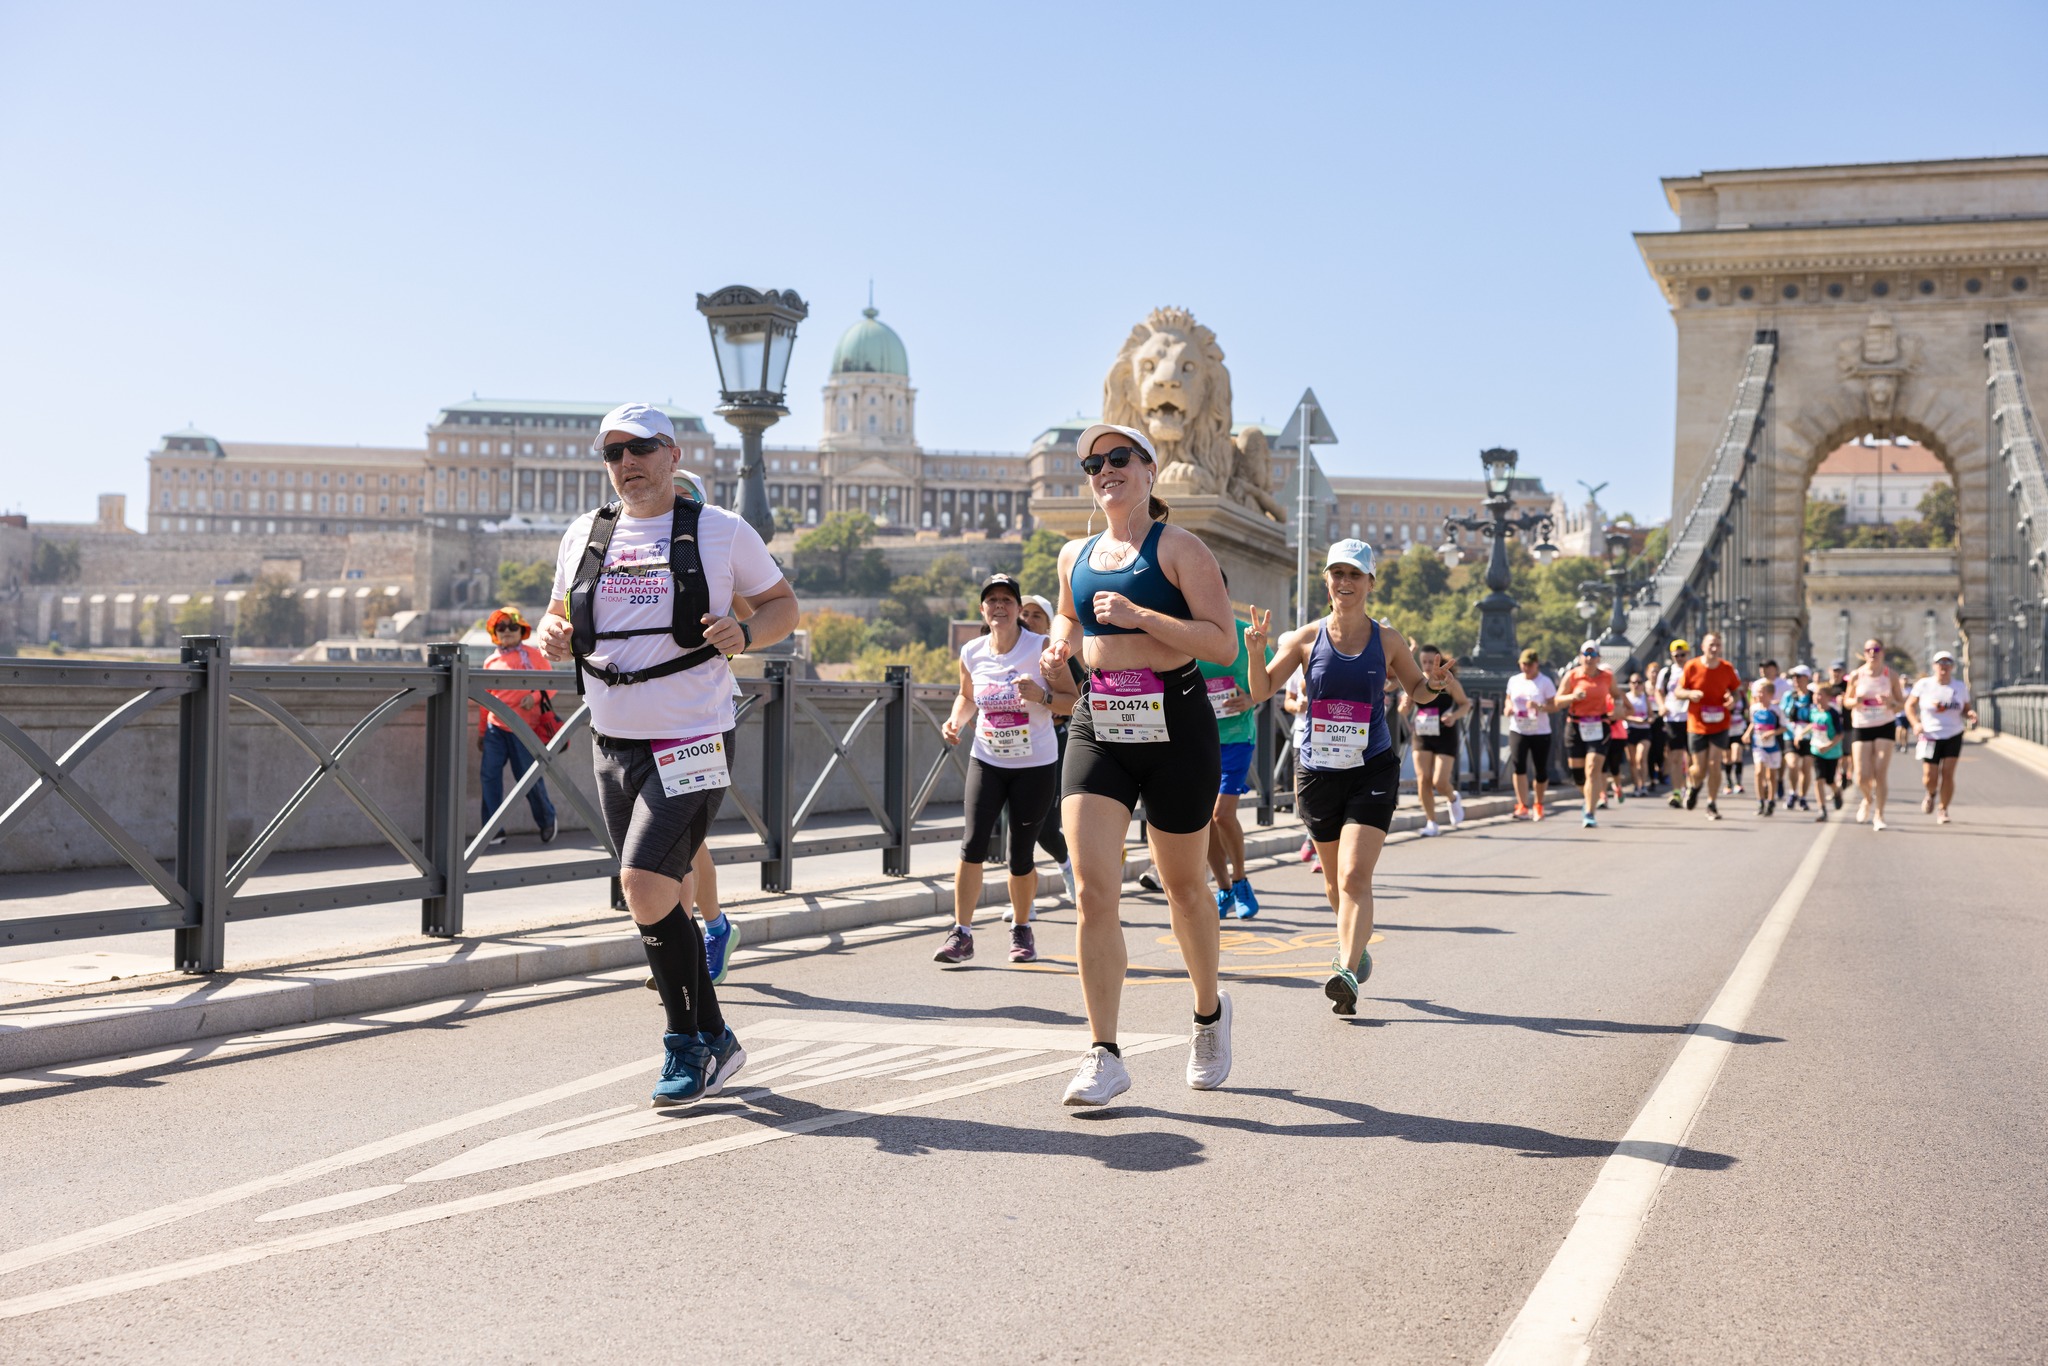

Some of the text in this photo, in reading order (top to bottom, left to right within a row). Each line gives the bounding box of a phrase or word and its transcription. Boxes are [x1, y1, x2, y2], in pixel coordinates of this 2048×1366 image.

[606, 578, 666, 586] BUDAPEST
[602, 585, 668, 594] FÉLMARATON
[630, 594, 659, 604] 2023
[1109, 700, 1149, 711] 20474
[1152, 701, 1159, 710] 6
[1121, 713, 1136, 722] EDIT
[1326, 724, 1358, 734] 20475
[676, 743, 714, 760] 21008
[716, 742, 720, 751] 5
